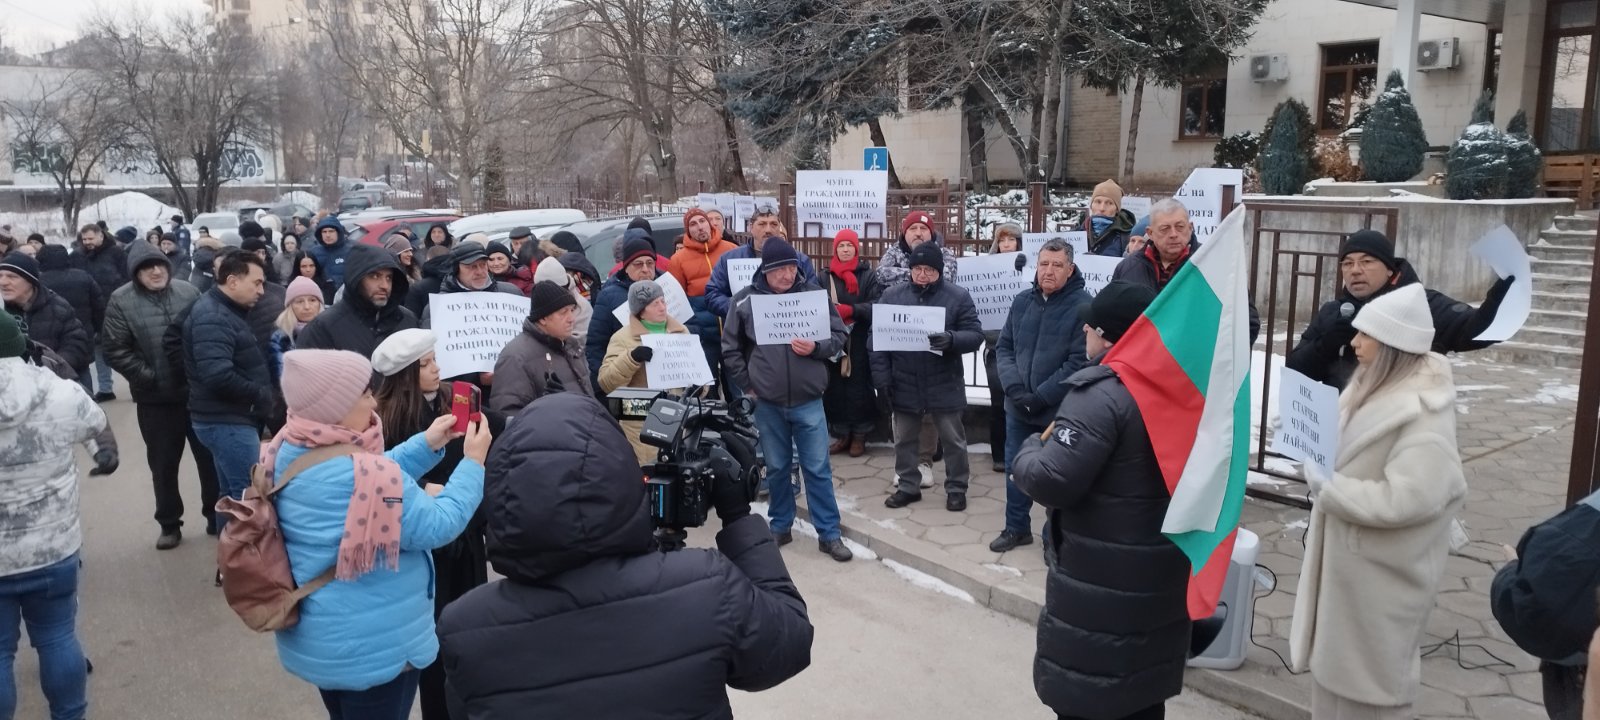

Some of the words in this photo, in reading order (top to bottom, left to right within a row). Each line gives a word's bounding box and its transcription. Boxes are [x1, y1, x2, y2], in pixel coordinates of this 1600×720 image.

[826, 176, 854, 186] ЧУЙТЕ
[804, 190, 862, 198] ГРАЖДАНИТЕ
[864, 190, 877, 198] НА
[1191, 188, 1205, 197] на
[802, 201, 841, 209] ОБЩИНА
[842, 201, 879, 209] ВЕЛИКО
[808, 212, 849, 220] ТЪРНОВО,
[825, 223, 862, 231] ТАНЧЕВ!
[1008, 282, 1021, 290] ОТ
[447, 302, 479, 312] ЧУВА
[482, 302, 499, 311] ЛИ
[502, 302, 527, 314] РИОС
[764, 308, 818, 319] КАРИЕРАТА!
[893, 312, 911, 323] НЕ
[464, 314, 508, 324] ГЛАСЪТ
[447, 326, 519, 339] ГРАЖДАНИТ
[445, 340, 501, 352] ОБЩИНА
[1292, 400, 1320, 425] СТАНЧЕВ,
